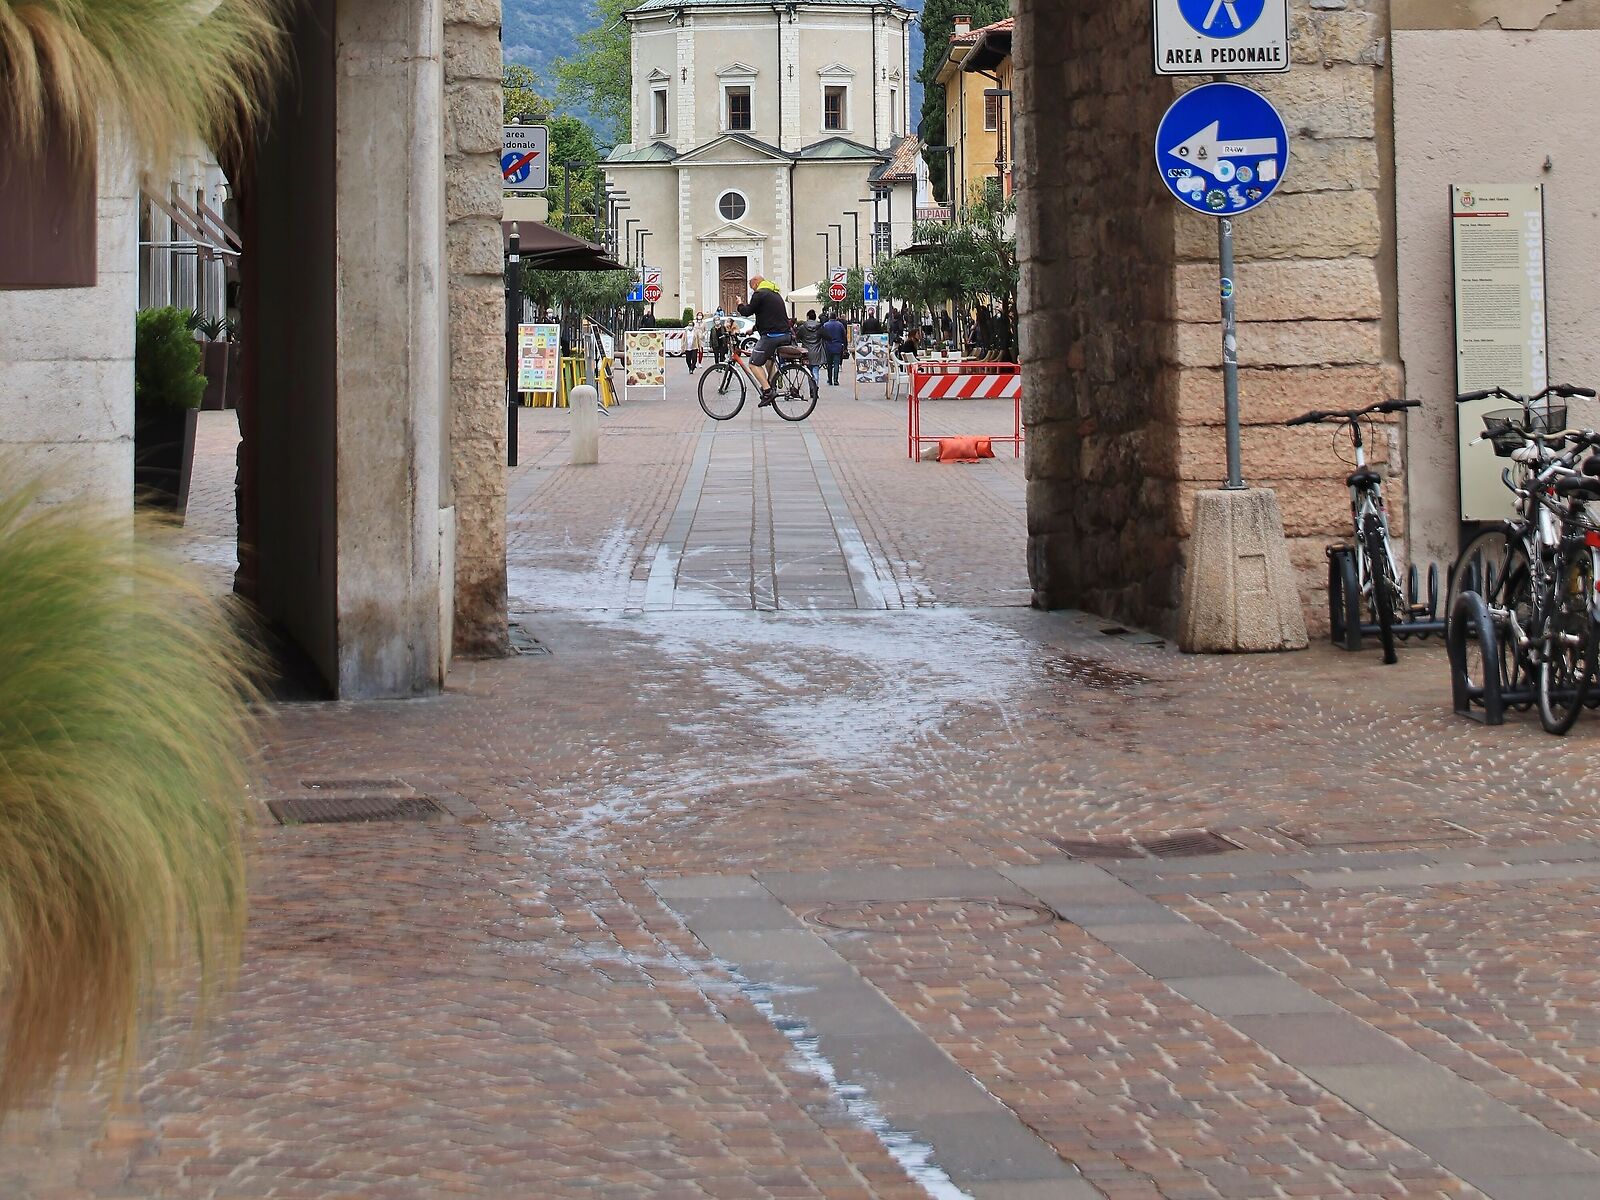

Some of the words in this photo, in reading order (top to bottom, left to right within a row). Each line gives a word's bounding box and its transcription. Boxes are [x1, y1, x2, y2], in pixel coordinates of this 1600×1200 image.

[1166, 48, 1203, 64] AREA
[1211, 47, 1281, 63] PEDONALE
[831, 288, 845, 297] STOP
